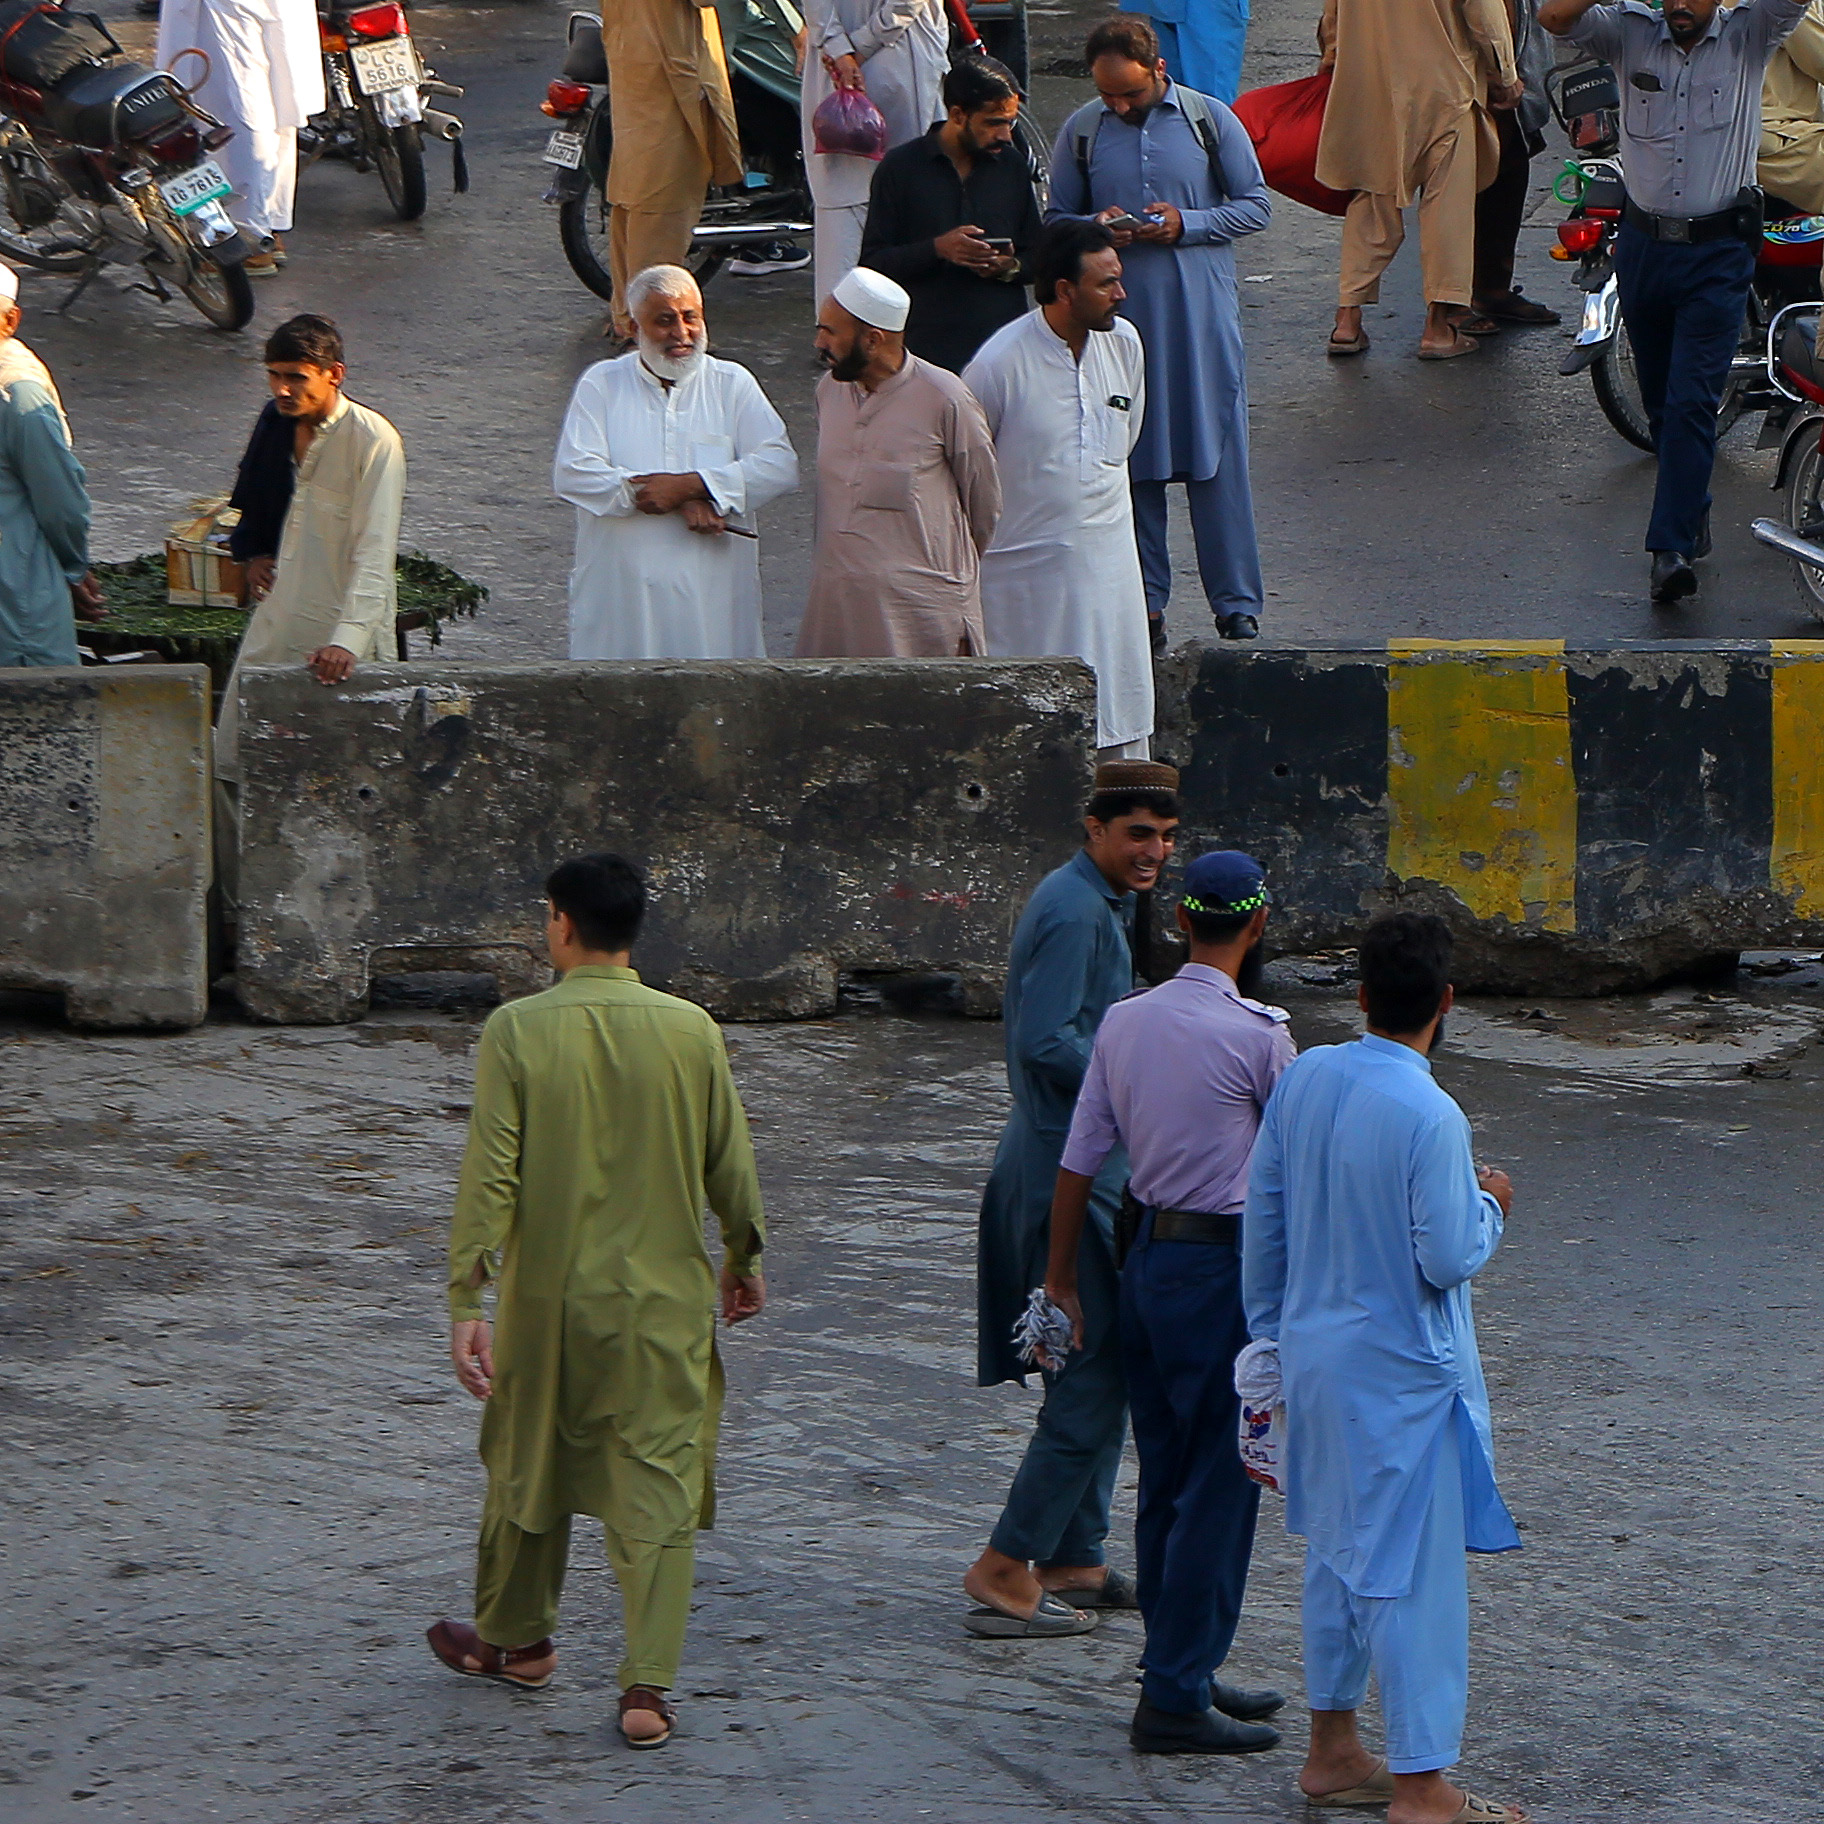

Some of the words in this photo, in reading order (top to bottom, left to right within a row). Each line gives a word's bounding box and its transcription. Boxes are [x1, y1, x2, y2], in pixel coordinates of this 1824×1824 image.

[371, 51, 396, 67] LC
[366, 63, 407, 84] 5616
[1565, 77, 1611, 98] HONDA
